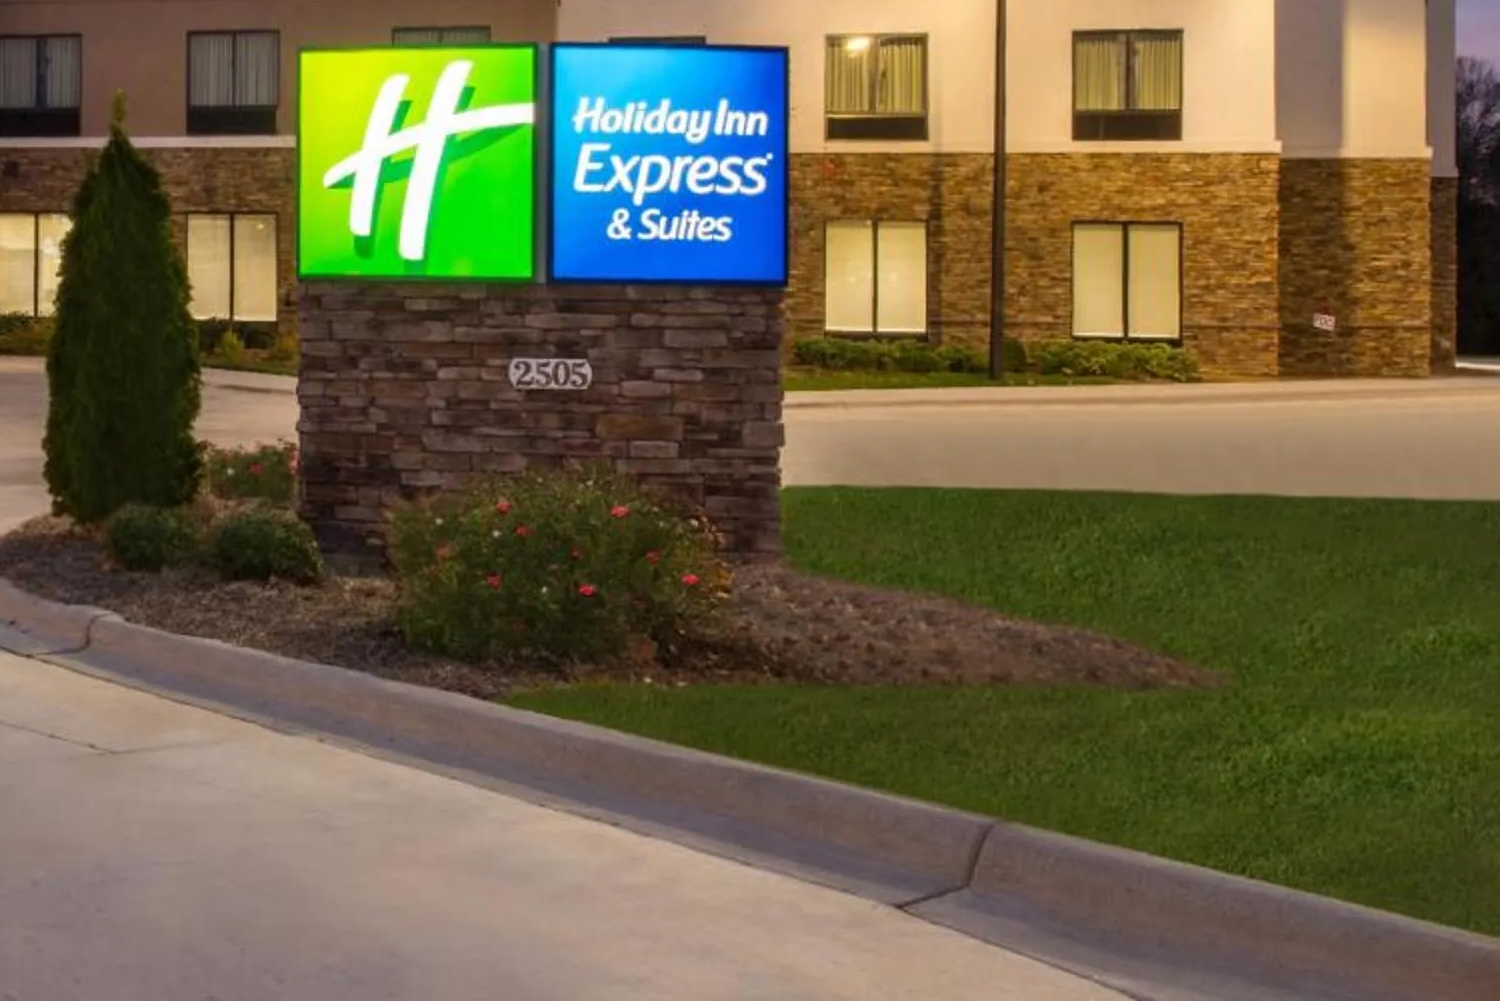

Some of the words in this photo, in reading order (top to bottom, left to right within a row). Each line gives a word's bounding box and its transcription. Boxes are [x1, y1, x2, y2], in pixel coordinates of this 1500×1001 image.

[572, 96, 713, 144] Holiday
[714, 97, 769, 136] Inn
[573, 143, 769, 206] Express
[606, 207, 632, 240] &
[636, 208, 733, 241] Suites
[513, 360, 589, 388] 2505
